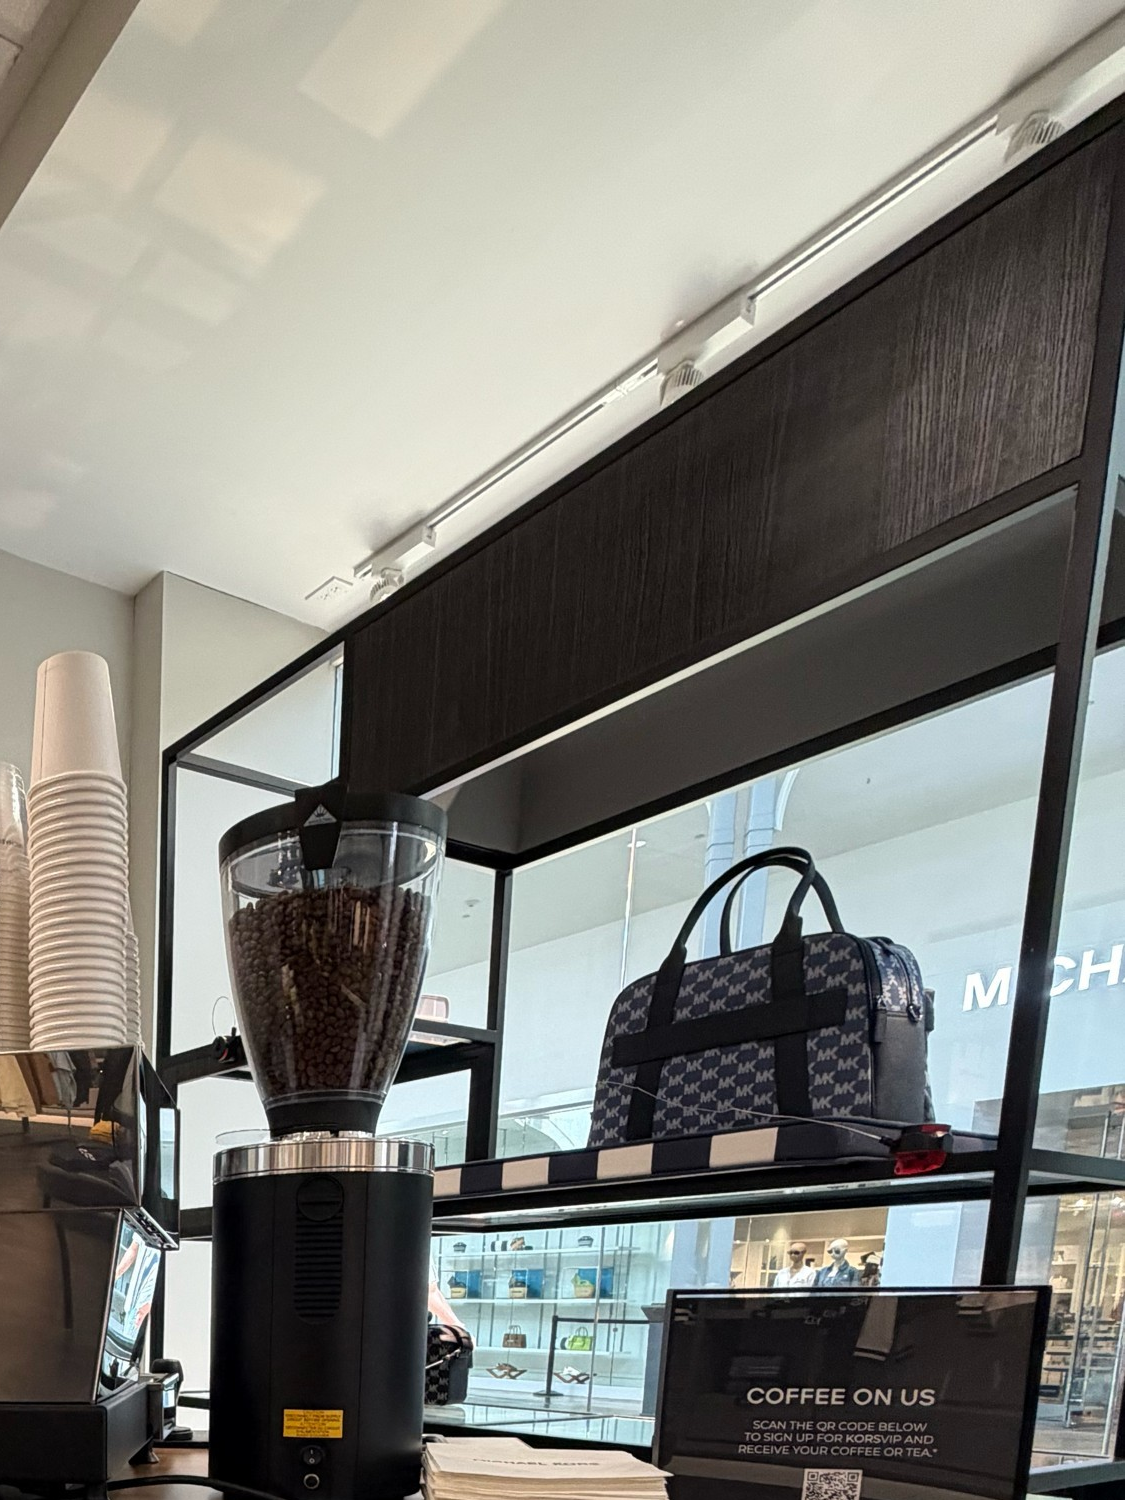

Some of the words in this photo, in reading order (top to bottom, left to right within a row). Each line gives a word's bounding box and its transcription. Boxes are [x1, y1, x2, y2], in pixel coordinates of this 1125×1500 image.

[811, 941, 829, 954] MK
[829, 949, 852, 963] MK
[733, 959, 752, 973] MK
[749, 966, 769, 979] MK
[807, 965, 826, 979] MK
[697, 968, 715, 982] MK
[712, 975, 729, 988] MK
[826, 973, 848, 988] MK
[962, 943, 1125, 1012] MCH
[634, 986, 650, 998] MK
[679, 983, 696, 997] MK
[728, 982, 747, 995] MK
[693, 990, 710, 1004] MK
[746, 990, 766, 1003] MK
[618, 1000, 632, 1013] MK
[709, 997, 726, 1011] MK
[630, 1008, 646, 1020] MK
[676, 1006, 692, 1020] MK
[845, 1006, 866, 1020] MK
[615, 1022, 629, 1035] MK
[840, 1031, 862, 1046] MK
[721, 1052, 739, 1065] MK
[817, 1047, 838, 1061] MK
[686, 1059, 703, 1072] MK
[738, 1060, 756, 1074] MK
[838, 1056, 858, 1070] MK
[702, 1067, 719, 1080] MK
[755, 1069, 774, 1082] MK
[814, 1072, 834, 1085] MK
[669, 1074, 685, 1087] MK
[718, 1076, 736, 1089] MK
[609, 1087, 621, 1097] MK
[684, 1082, 700, 1095] MK
[736, 1084, 754, 1097] MK
[834, 1081, 855, 1094] MK
[700, 1090, 717, 1103] MK
[754, 1092, 773, 1105] MK
[812, 1096, 832, 1109] MK
[596, 1100, 607, 1110] MK
[718, 1100, 734, 1111] MK
[606, 1108, 620, 1118] MK
[700, 1112, 716, 1125] MK
[735, 1107, 753, 1120] MK
[593, 1119, 605, 1130] MK
[666, 1118, 682, 1130] MK
[605, 1128, 619, 1139] MK
[747, 1388, 845, 1405] COFFEE
[853, 1388, 892, 1406] ON
[901, 1389, 935, 1406] US
[753, 1421, 786, 1430] SCAN
[789, 1421, 814, 1431] THE
[816, 1422, 836, 1432] QR
[838, 1422, 875, 1432] CODE
[878, 1422, 927, 1432] BELOW
[745, 1432, 760, 1442] TO
[763, 1432, 792, 1442] SIGN
[796, 1433, 813, 1442] UP
[816, 1433, 843, 1443] FOR
[846, 1434, 901, 1444] KORSVIP
[904, 1435, 934, 1444] AND
[738, 1445, 789, 1455] RECEIVE
[793, 1446, 827, 1455] YOUR
[831, 1446, 881, 1456] COFFEE
[884, 1447, 903, 1457] OR
